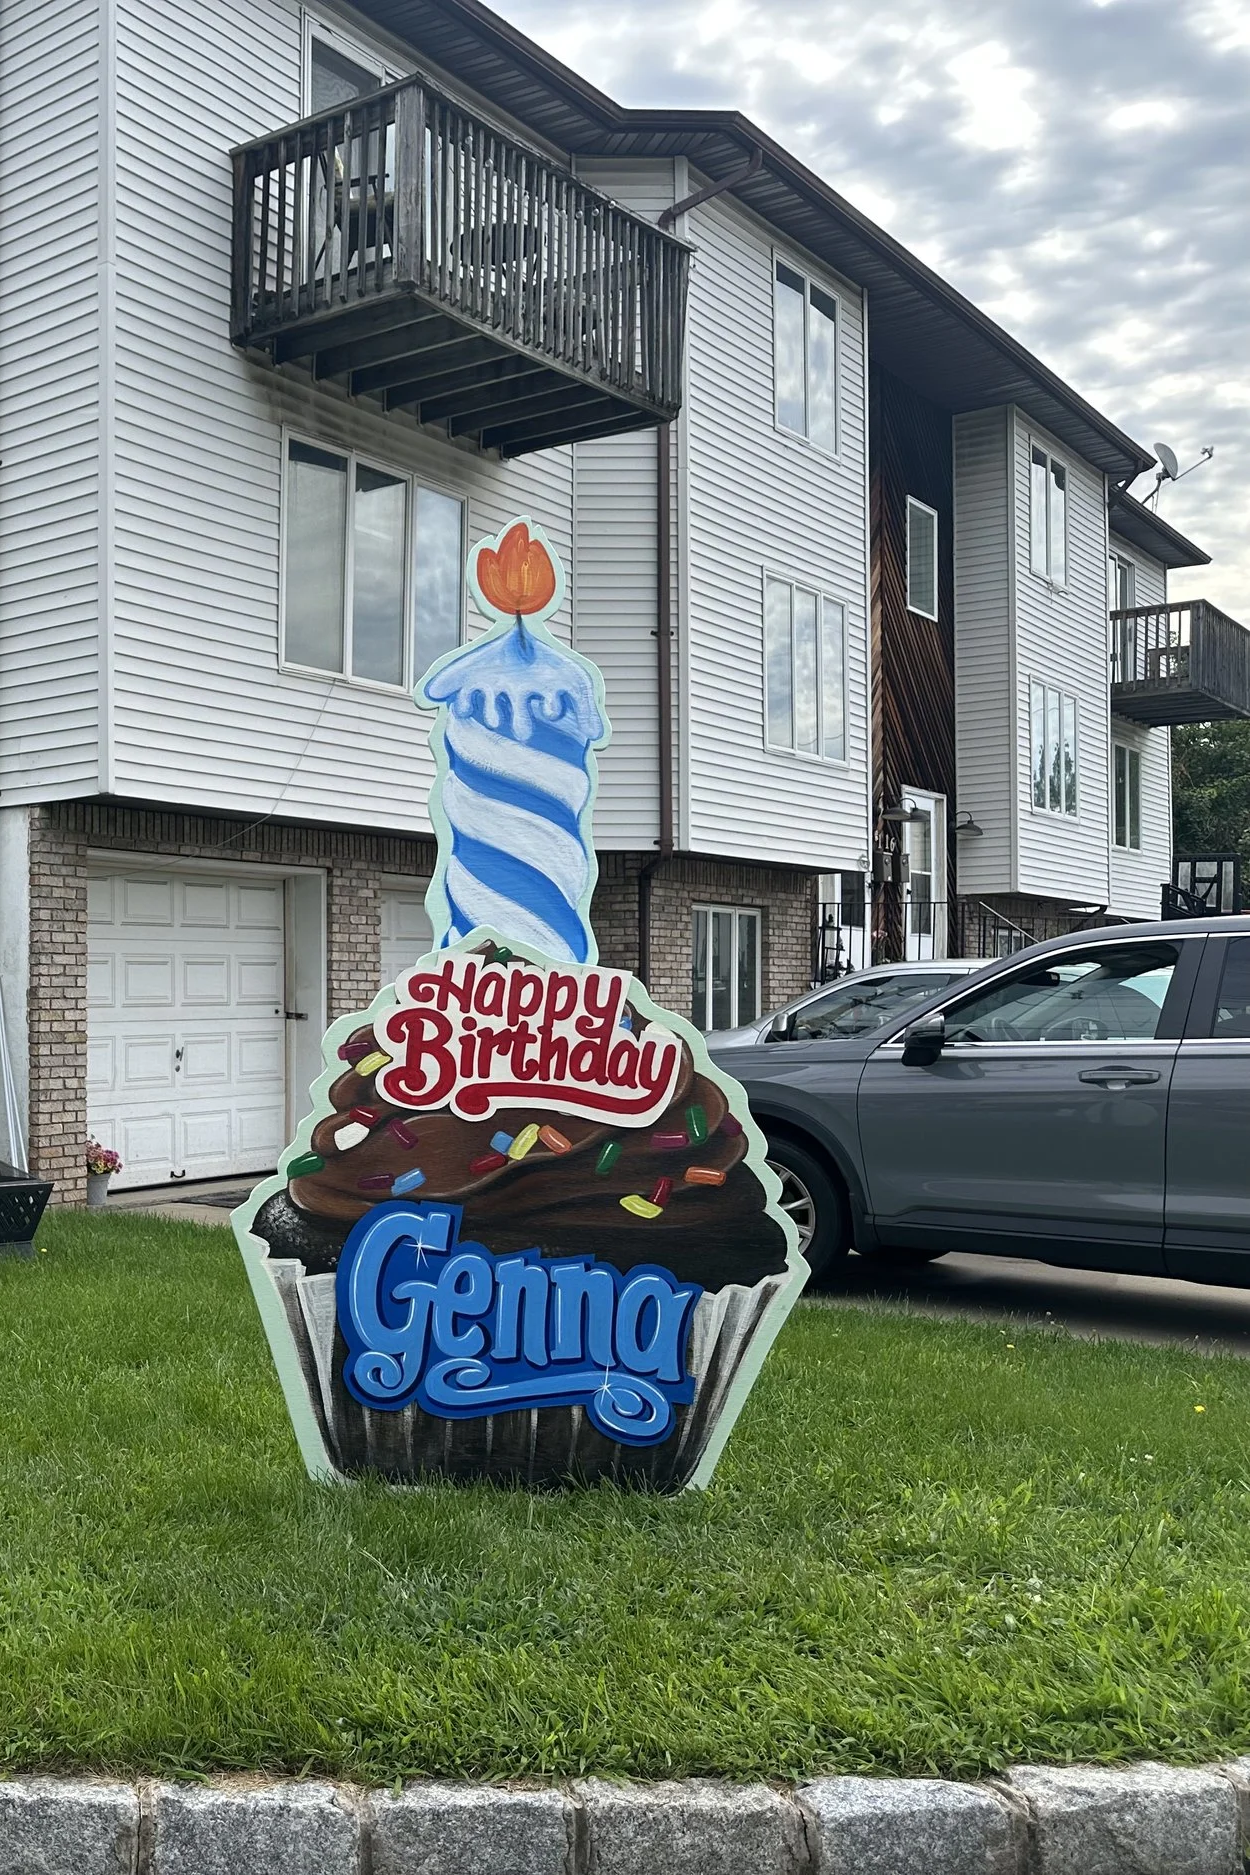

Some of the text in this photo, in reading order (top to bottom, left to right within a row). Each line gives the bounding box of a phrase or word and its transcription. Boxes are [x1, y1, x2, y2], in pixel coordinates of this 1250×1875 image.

[410, 961, 624, 1045] Happy
[385, 1010, 676, 1114] Birthday
[350, 1210, 695, 1436] Genna
